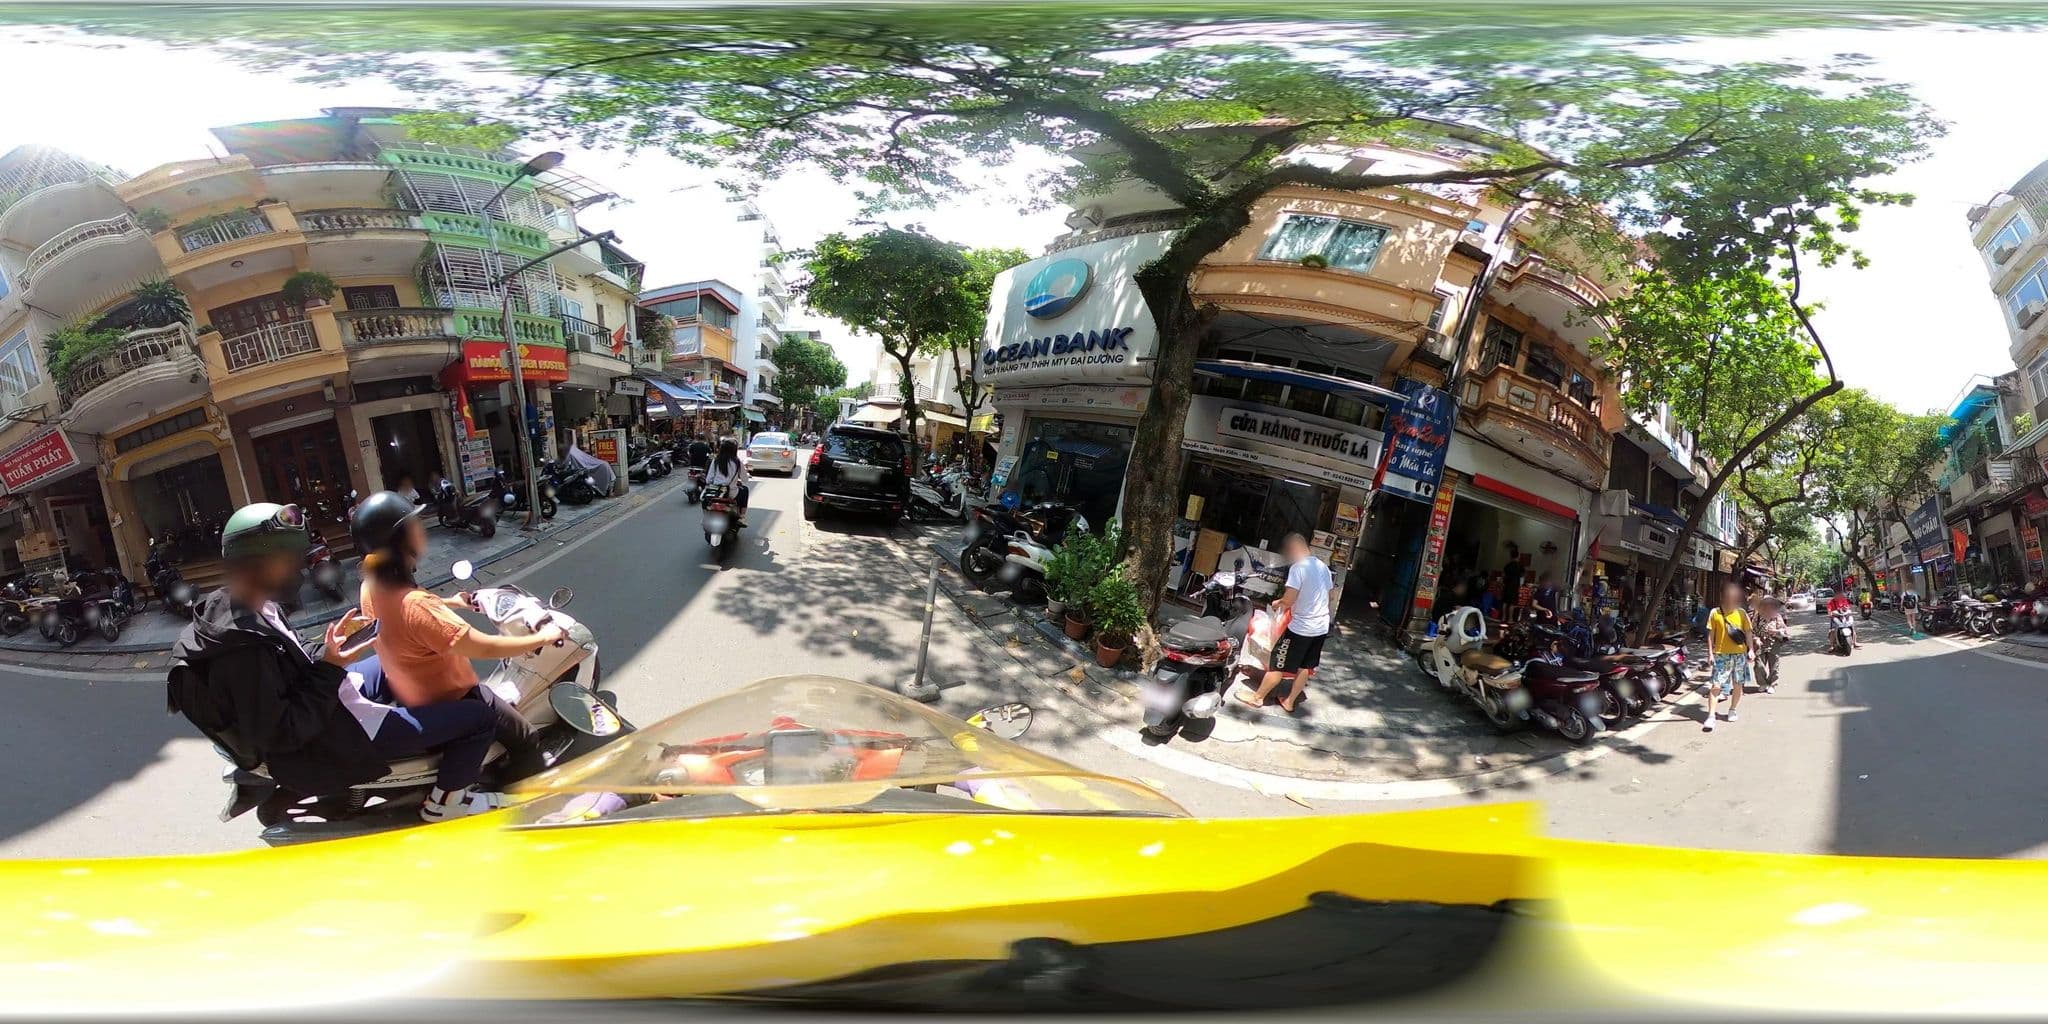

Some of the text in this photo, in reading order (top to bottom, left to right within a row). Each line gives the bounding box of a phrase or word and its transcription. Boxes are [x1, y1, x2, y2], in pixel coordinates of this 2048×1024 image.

[1031, 360, 1050, 369] TNHH
[1052, 357, 1069, 367] MTV
[1071, 355, 1086, 367] ĐẠI
[1087, 352, 1124, 365] DƯƠNG
[1302, 430, 1350, 455] THUỐC
[1351, 440, 1369, 460] LÁ
[7, 448, 63, 481] TUẤN PHÁT
[1277, 638, 1291, 669] adidas
